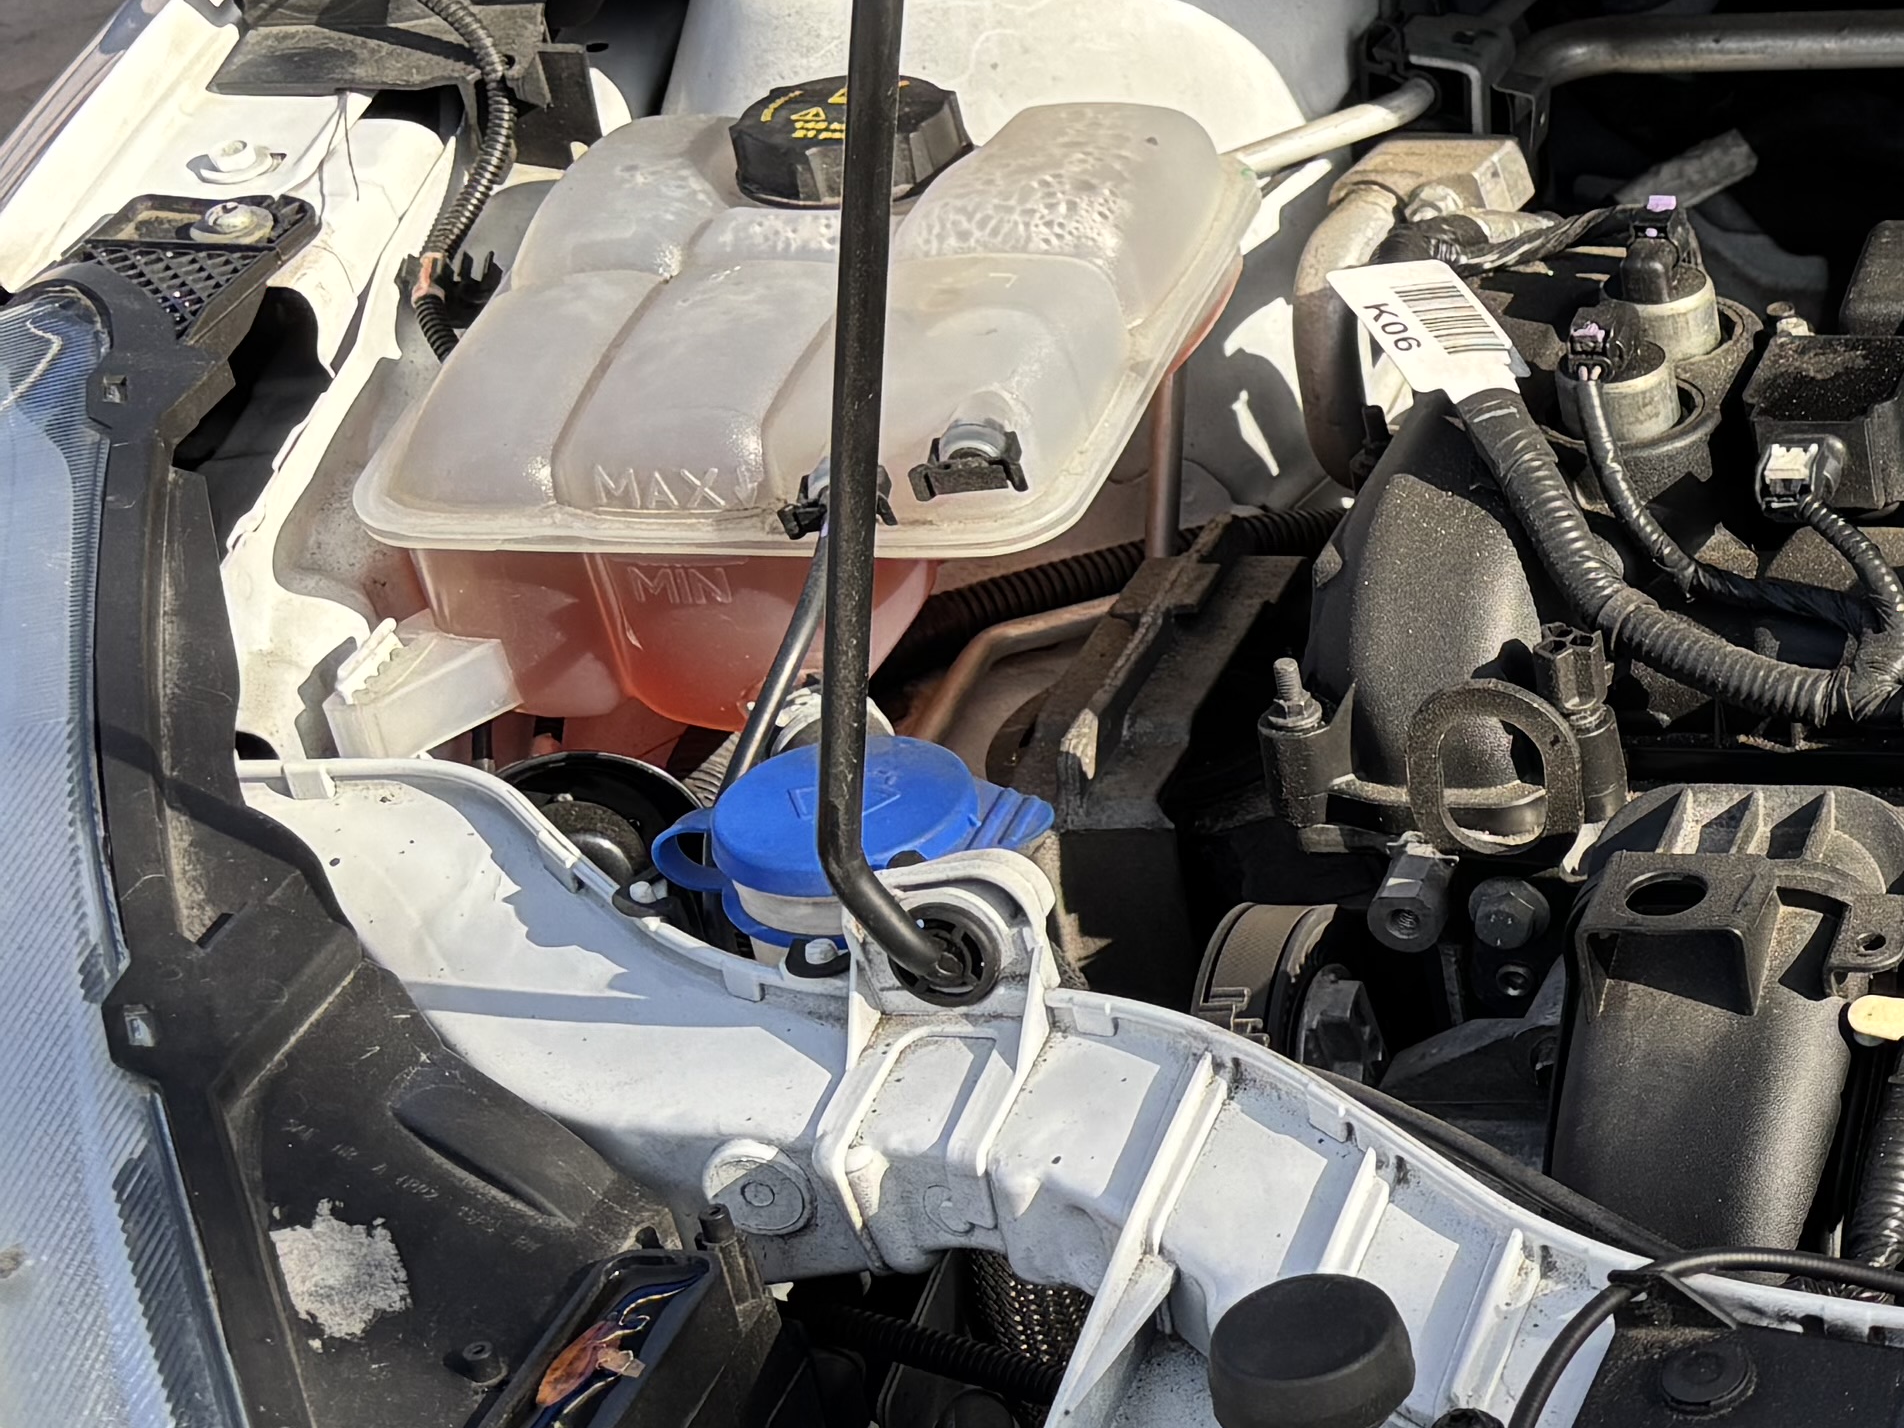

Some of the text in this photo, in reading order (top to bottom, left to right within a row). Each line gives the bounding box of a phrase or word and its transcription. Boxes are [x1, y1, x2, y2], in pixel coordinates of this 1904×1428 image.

[1362, 302, 1422, 353] K06
[593, 462, 727, 510] MAX
[627, 564, 733, 605] MIN
